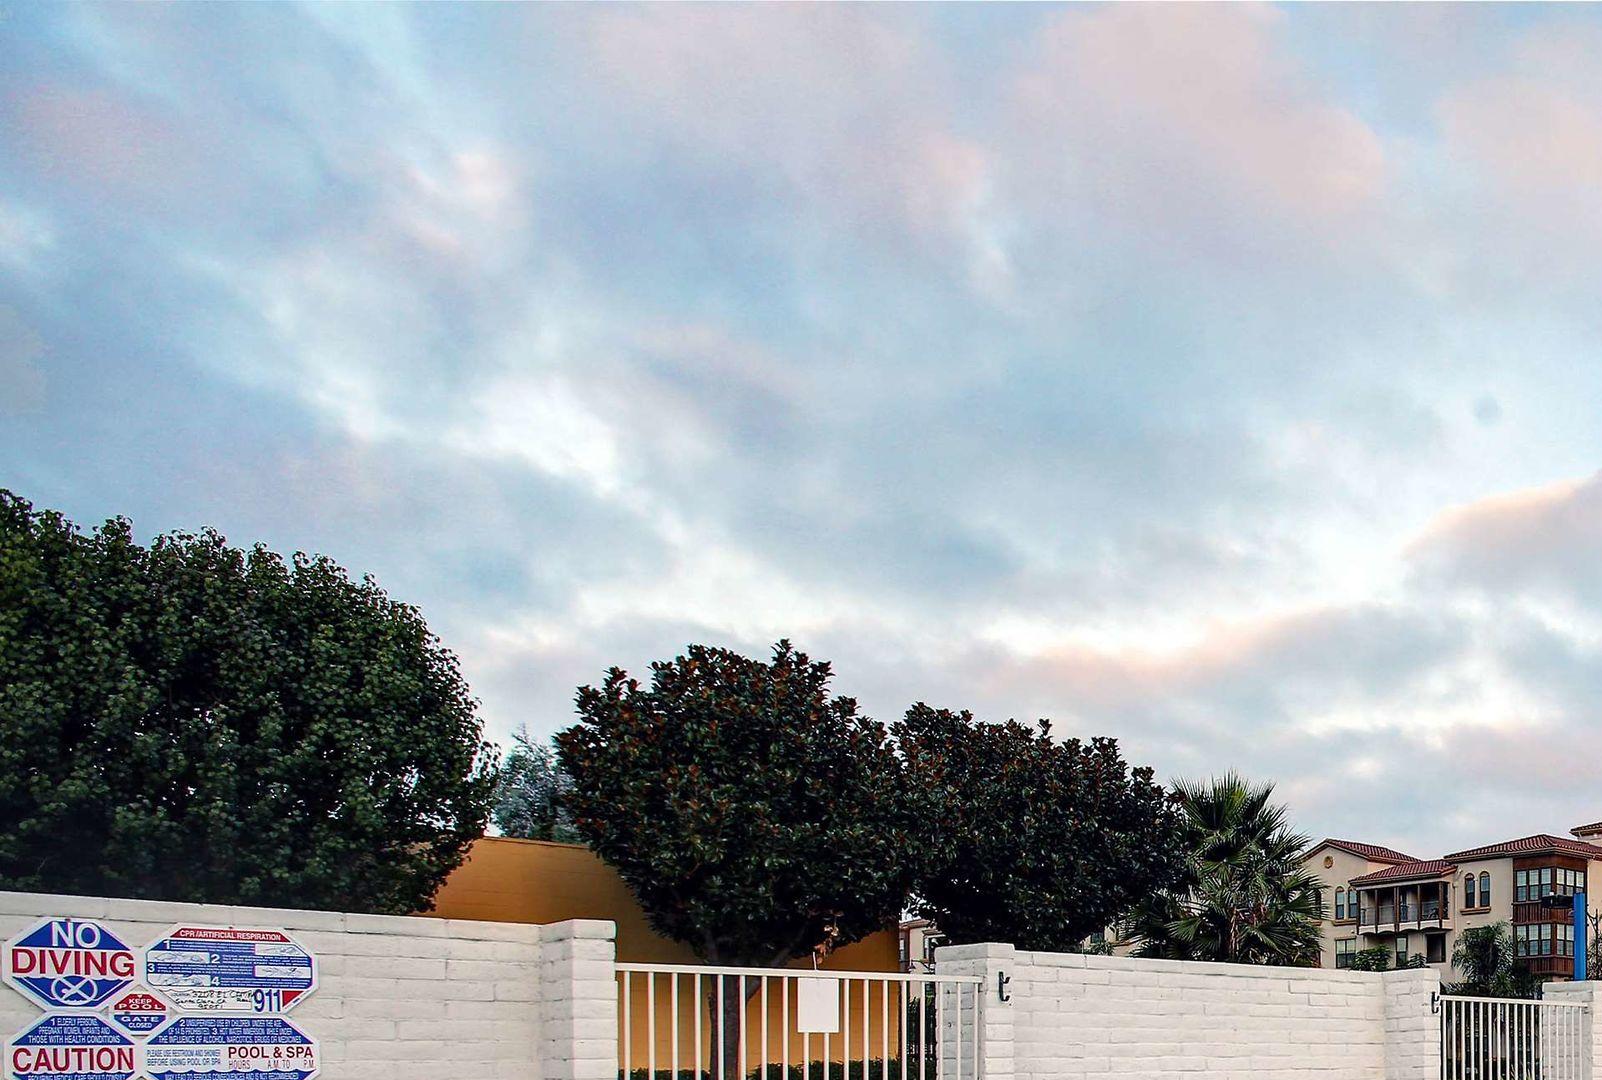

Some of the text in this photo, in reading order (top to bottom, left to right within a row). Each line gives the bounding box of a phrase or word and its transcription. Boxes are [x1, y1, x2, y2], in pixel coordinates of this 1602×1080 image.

[52, 921, 101, 949] NO
[237, 932, 281, 941] RESPIRATION
[163, 940, 170, 950] 1
[12, 948, 134, 977] DIVING
[210, 954, 220, 964] 2
[147, 963, 155, 973] 3
[211, 976, 220, 986] 4
[254, 988, 281, 1013] 911
[28, 1035, 120, 1043] THOSE WITH HEALTH CONDITIONS
[228, 1046, 314, 1059] POOL & SPA
[13, 1047, 134, 1073] CAUTION
[228, 1059, 251, 1069] HOURS
[282, 1059, 291, 1069] TO
